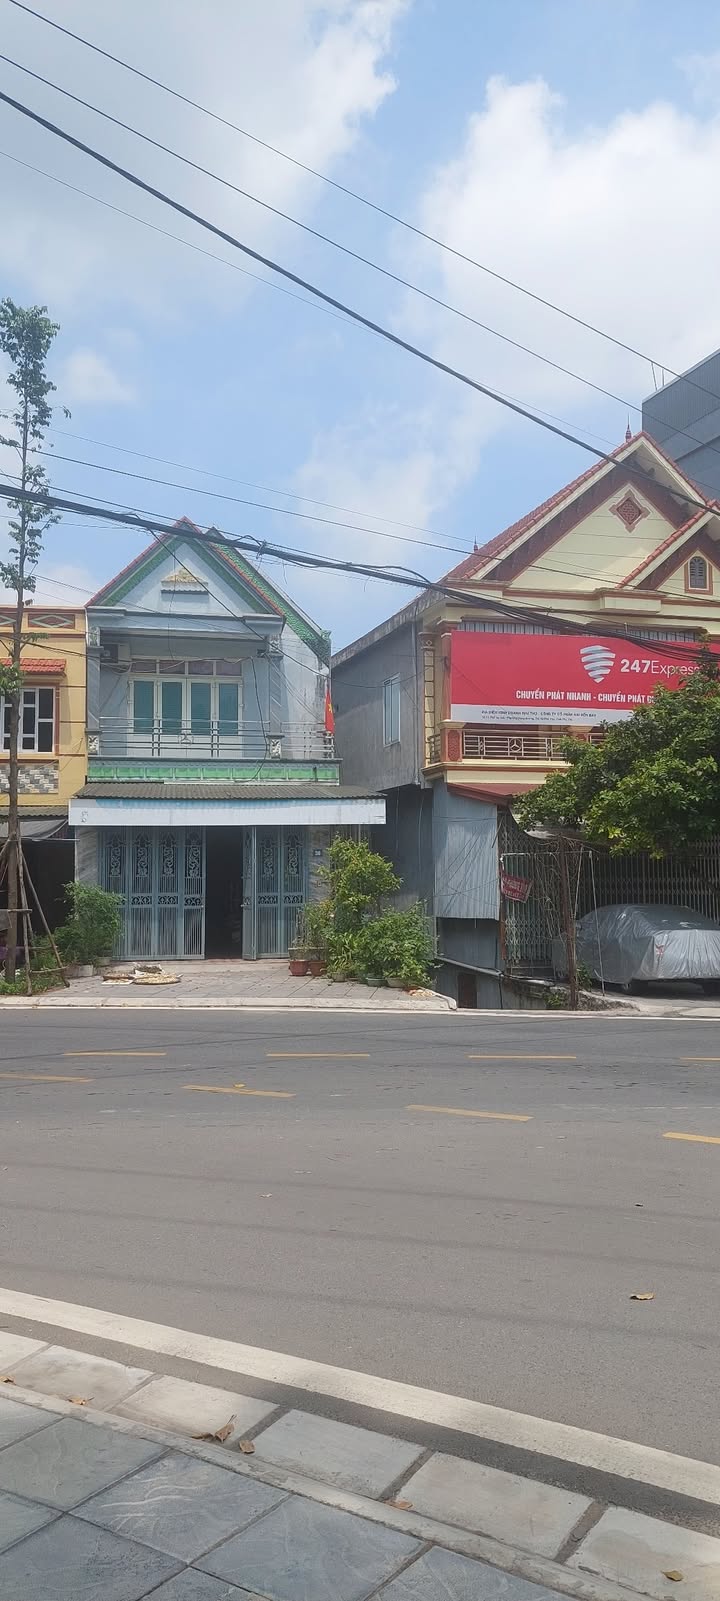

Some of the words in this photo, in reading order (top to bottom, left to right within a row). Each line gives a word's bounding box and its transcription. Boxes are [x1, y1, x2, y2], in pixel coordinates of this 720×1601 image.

[546, 690, 565, 700] PHÁT
[566, 691, 592, 701] NHANH
[627, 693, 646, 704] PHÁT
